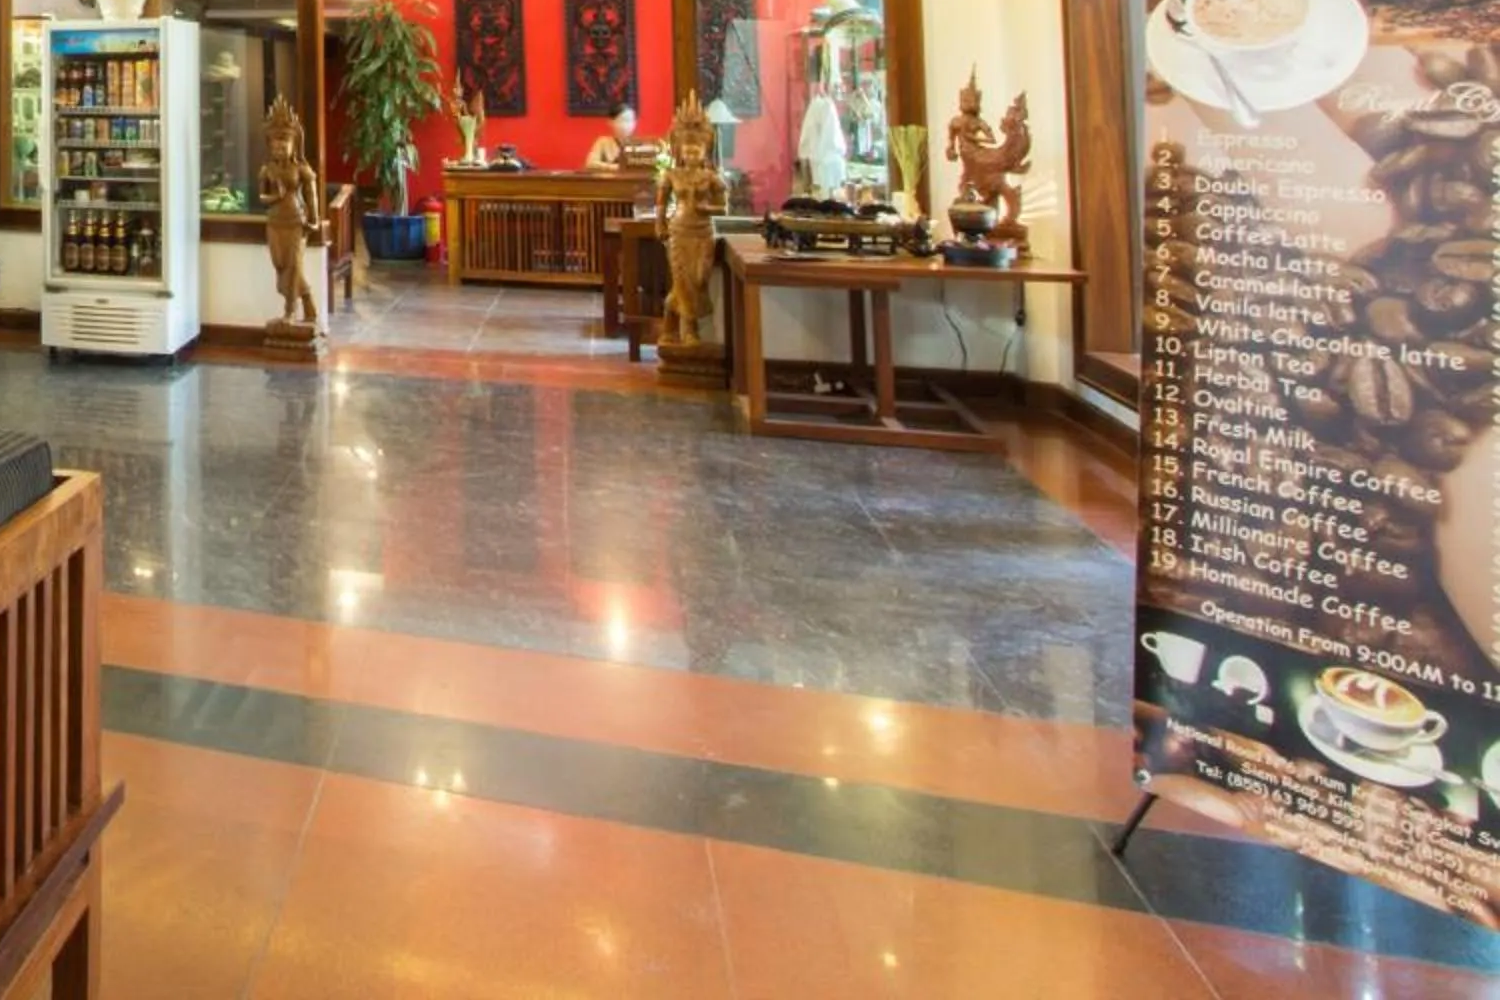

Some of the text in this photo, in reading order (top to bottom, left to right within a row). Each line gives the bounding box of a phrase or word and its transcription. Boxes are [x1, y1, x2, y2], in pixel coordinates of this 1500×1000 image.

[1196, 128, 1299, 150] Espresso
[1197, 154, 1316, 175] Americano
[1194, 175, 1270, 197] Double
[1277, 179, 1387, 204] Espresso
[1195, 198, 1321, 225] Cappuccino
[1195, 222, 1274, 246] Coffee
[1280, 227, 1348, 252] Latte
[1195, 246, 1269, 270] Mocha
[1275, 252, 1341, 277] Latte
[1194, 269, 1285, 296] Caramel
[1291, 277, 1352, 304] latte
[1194, 293, 1262, 318] Vanila
[1268, 300, 1327, 326] latte
[1154, 336, 1316, 376] 10. Lipton Tea
[1194, 317, 1265, 343] White
[1270, 328, 1392, 361] Chocolate
[1400, 345, 1467, 371] latte
[1154, 360, 1323, 402] 11. Herbal Tea
[1154, 383, 1289, 422] 12. Ovaltine
[1153, 407, 1316, 452] 13. Fresh Milk
[1152, 431, 1443, 505] 14. Royal Empire Coffee
[1152, 454, 1365, 516] 15. French Coffee
[1152, 478, 1370, 543] 16. Russian Coffee
[1151, 526, 1339, 590] 18. Irish Coffee
[1152, 502, 1410, 580] 17. Millionaire Coffee
[1189, 561, 1315, 609] Homemade
[1320, 595, 1414, 636] Coffee
[1200, 601, 1293, 643] Operation
[1298, 627, 1352, 661] From
[1355, 644, 1445, 687] 9:00AM
[1449, 672, 1476, 695] to
[1227, 771, 1269, 799] (855)
[1296, 797, 1328, 819] 969
